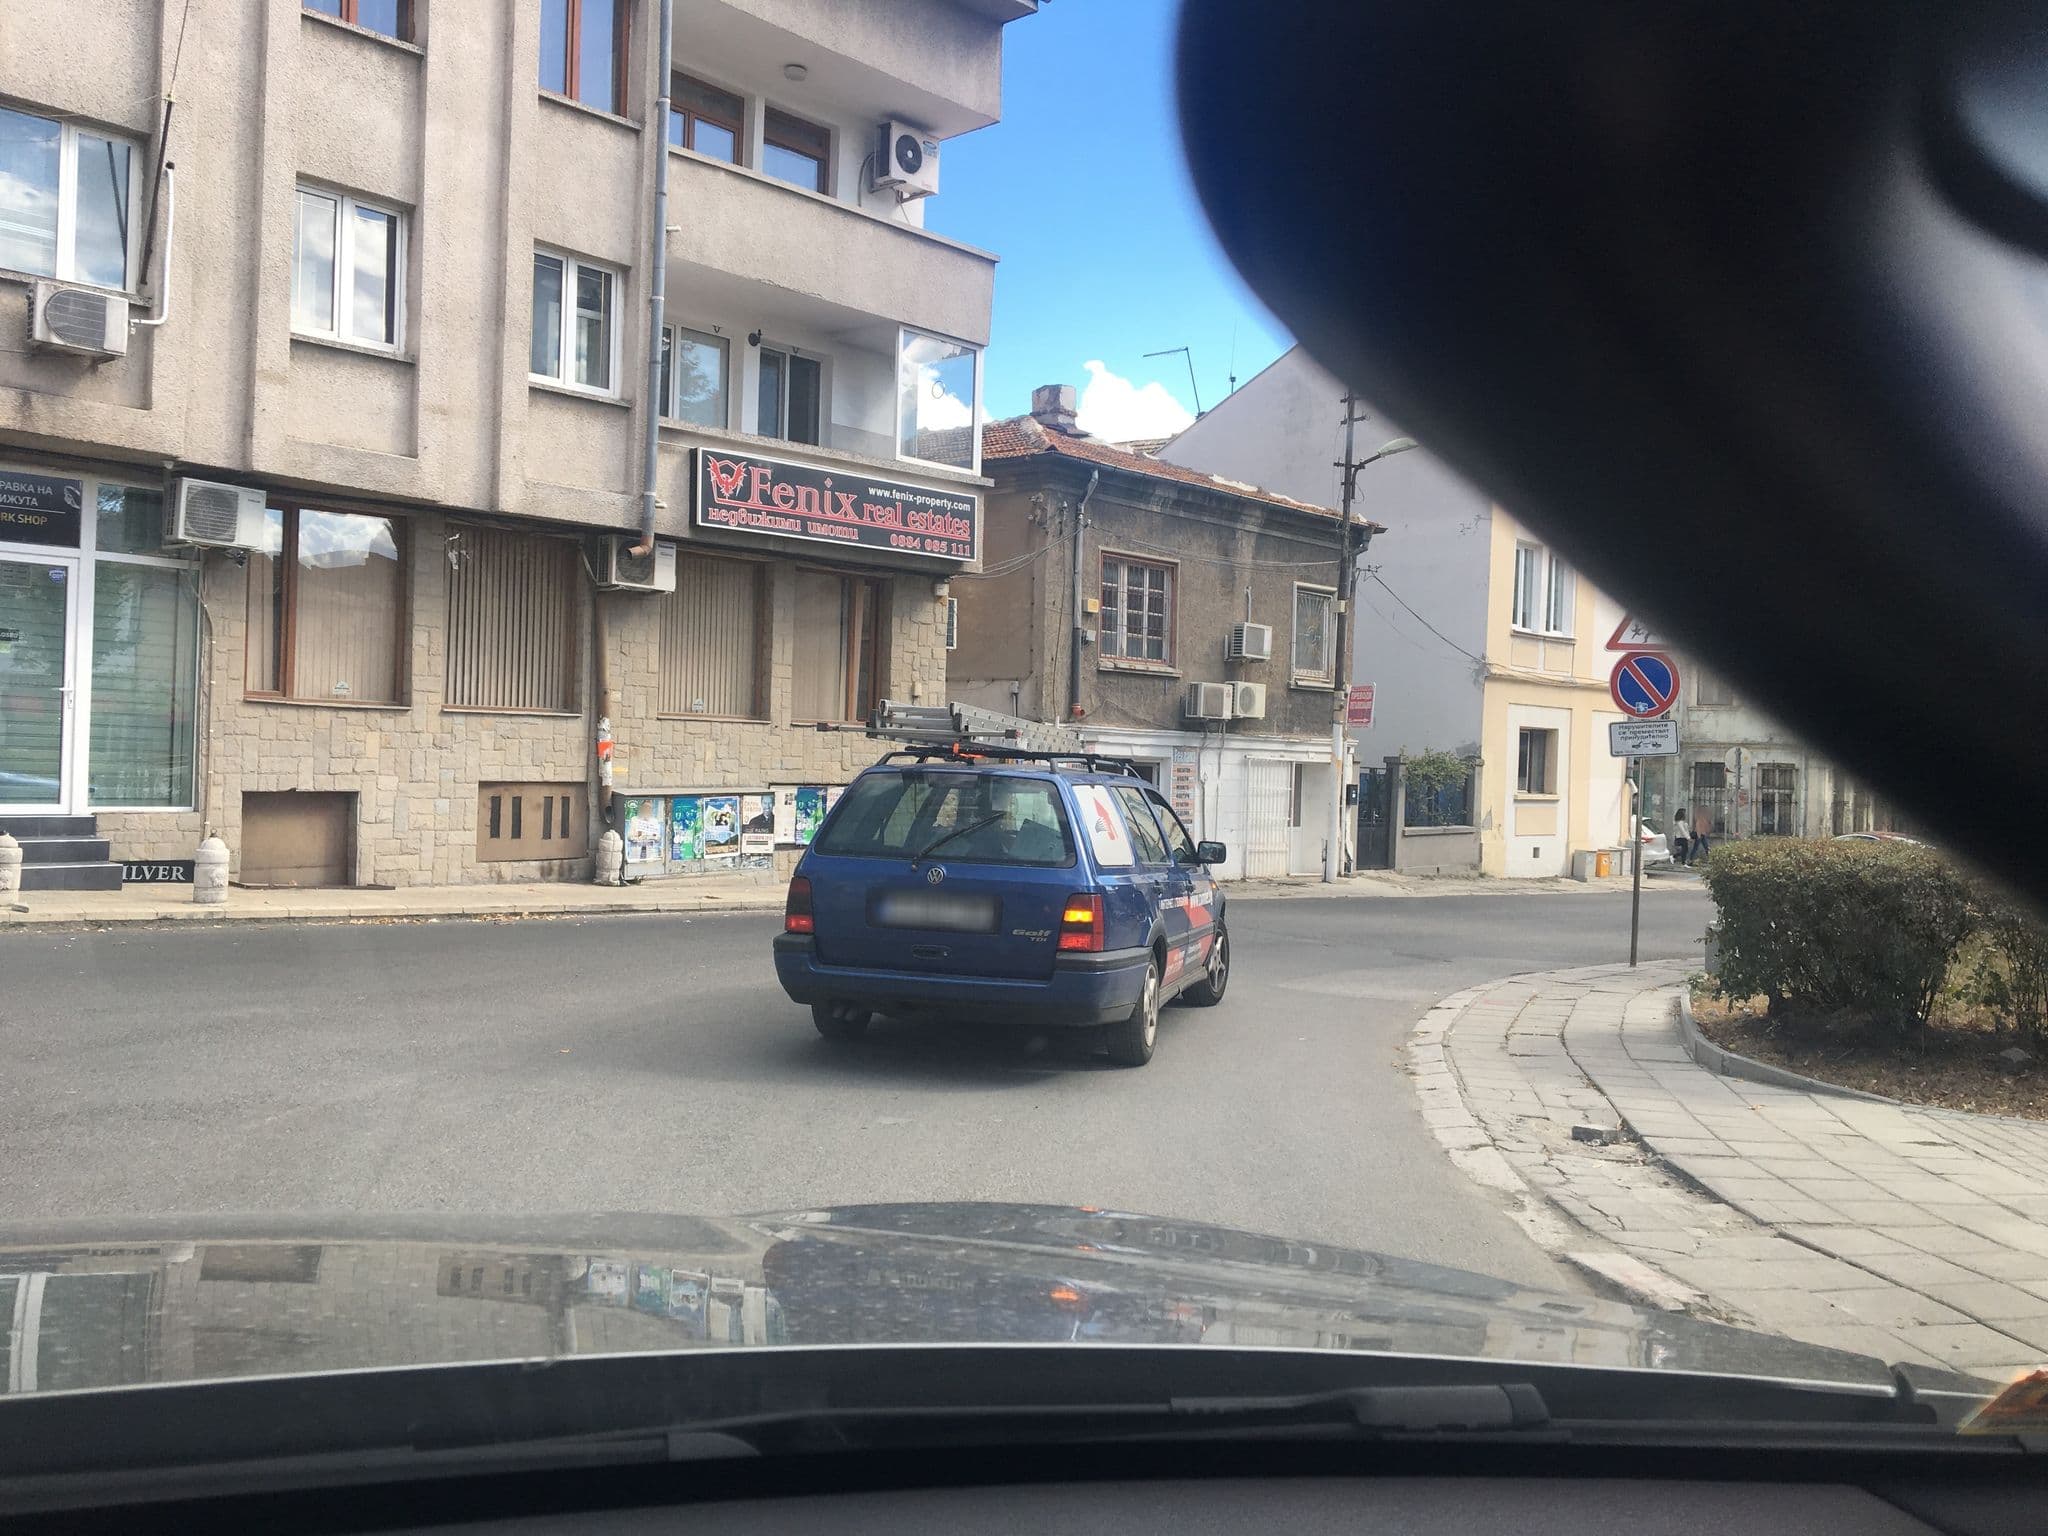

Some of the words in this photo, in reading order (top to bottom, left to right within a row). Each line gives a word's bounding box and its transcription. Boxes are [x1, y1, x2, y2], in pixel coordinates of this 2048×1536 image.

[37, 485, 53, 496] НА
[747, 465, 859, 520] Fenix
[863, 502, 903, 527] real
[907, 508, 970, 537] estates
[868, 487, 971, 512] www.fenix-property.com
[18, 513, 48, 525] SHOP
[951, 543, 971, 557] 111
